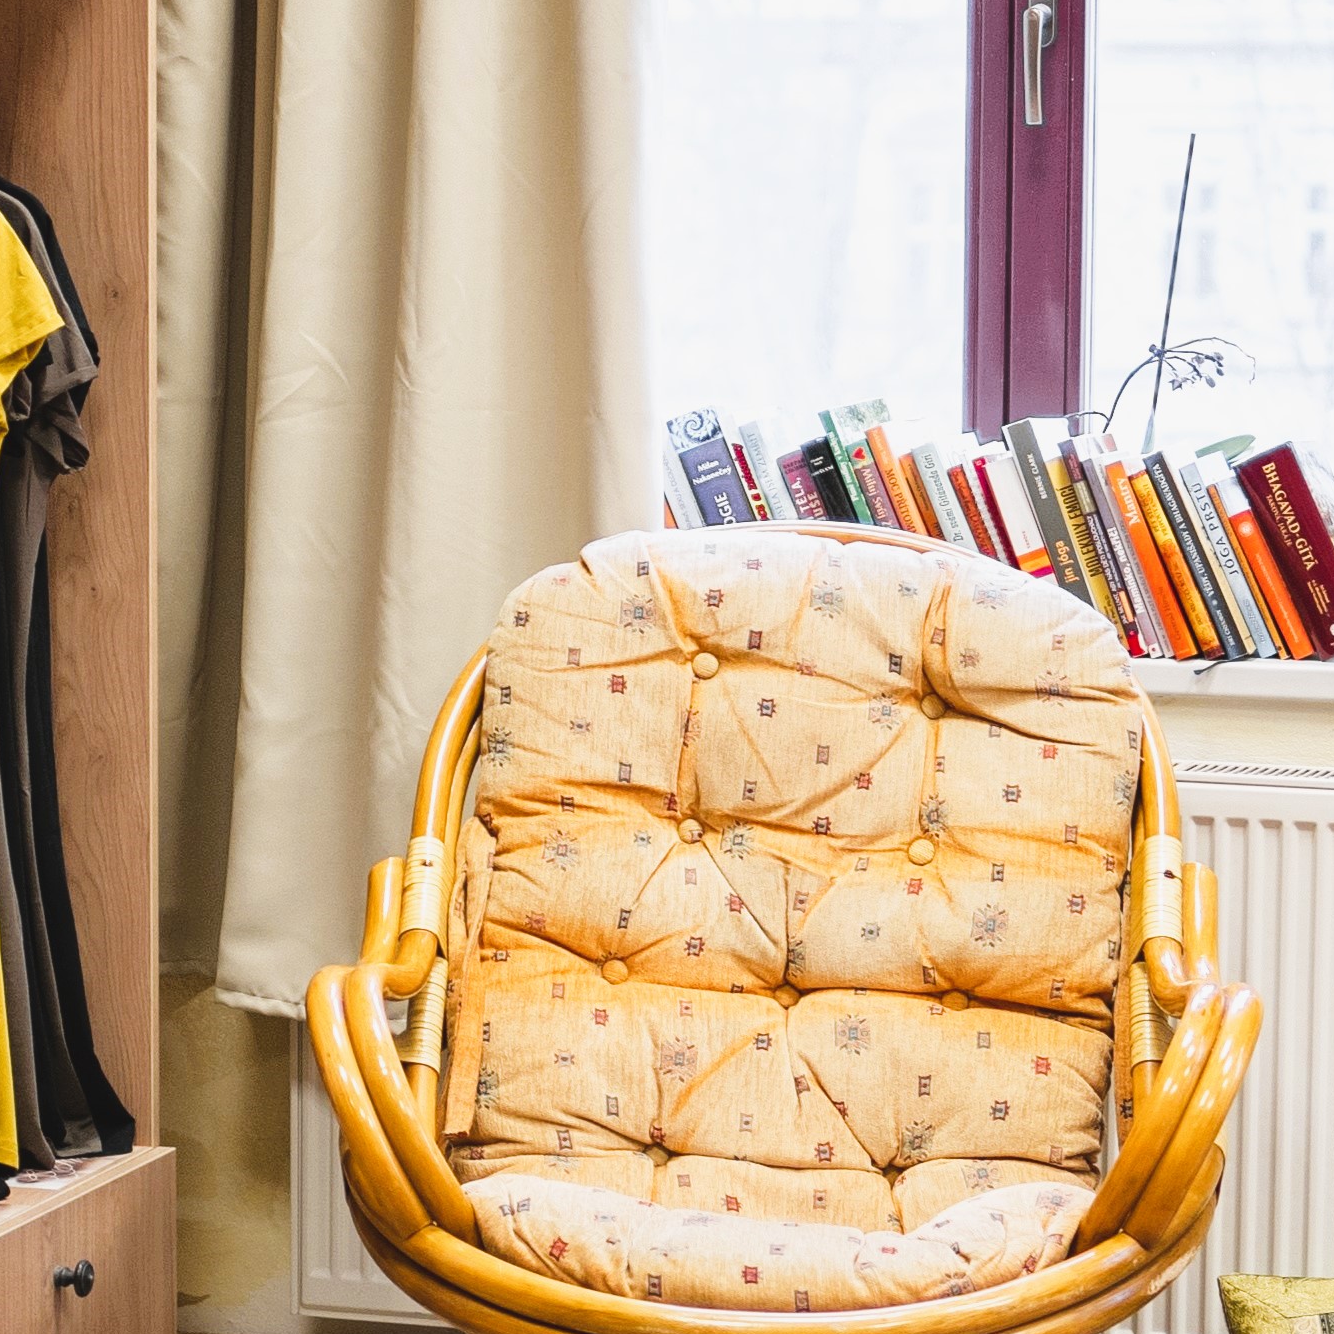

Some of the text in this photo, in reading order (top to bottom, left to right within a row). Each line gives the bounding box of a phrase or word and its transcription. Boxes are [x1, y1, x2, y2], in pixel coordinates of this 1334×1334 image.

[885, 469, 900, 491] MOC
[922, 454, 935, 469] Giri
[714, 492, 737, 526] OGIE
[1116, 478, 1140, 525] Mantry
[1073, 523, 1103, 577] MOLEKULY
[1188, 483, 1239, 575] JÓGA PRSTŮ
[1182, 531, 1205, 573] UPANIŠADY
[1120, 563, 1144, 615] Maminko,
